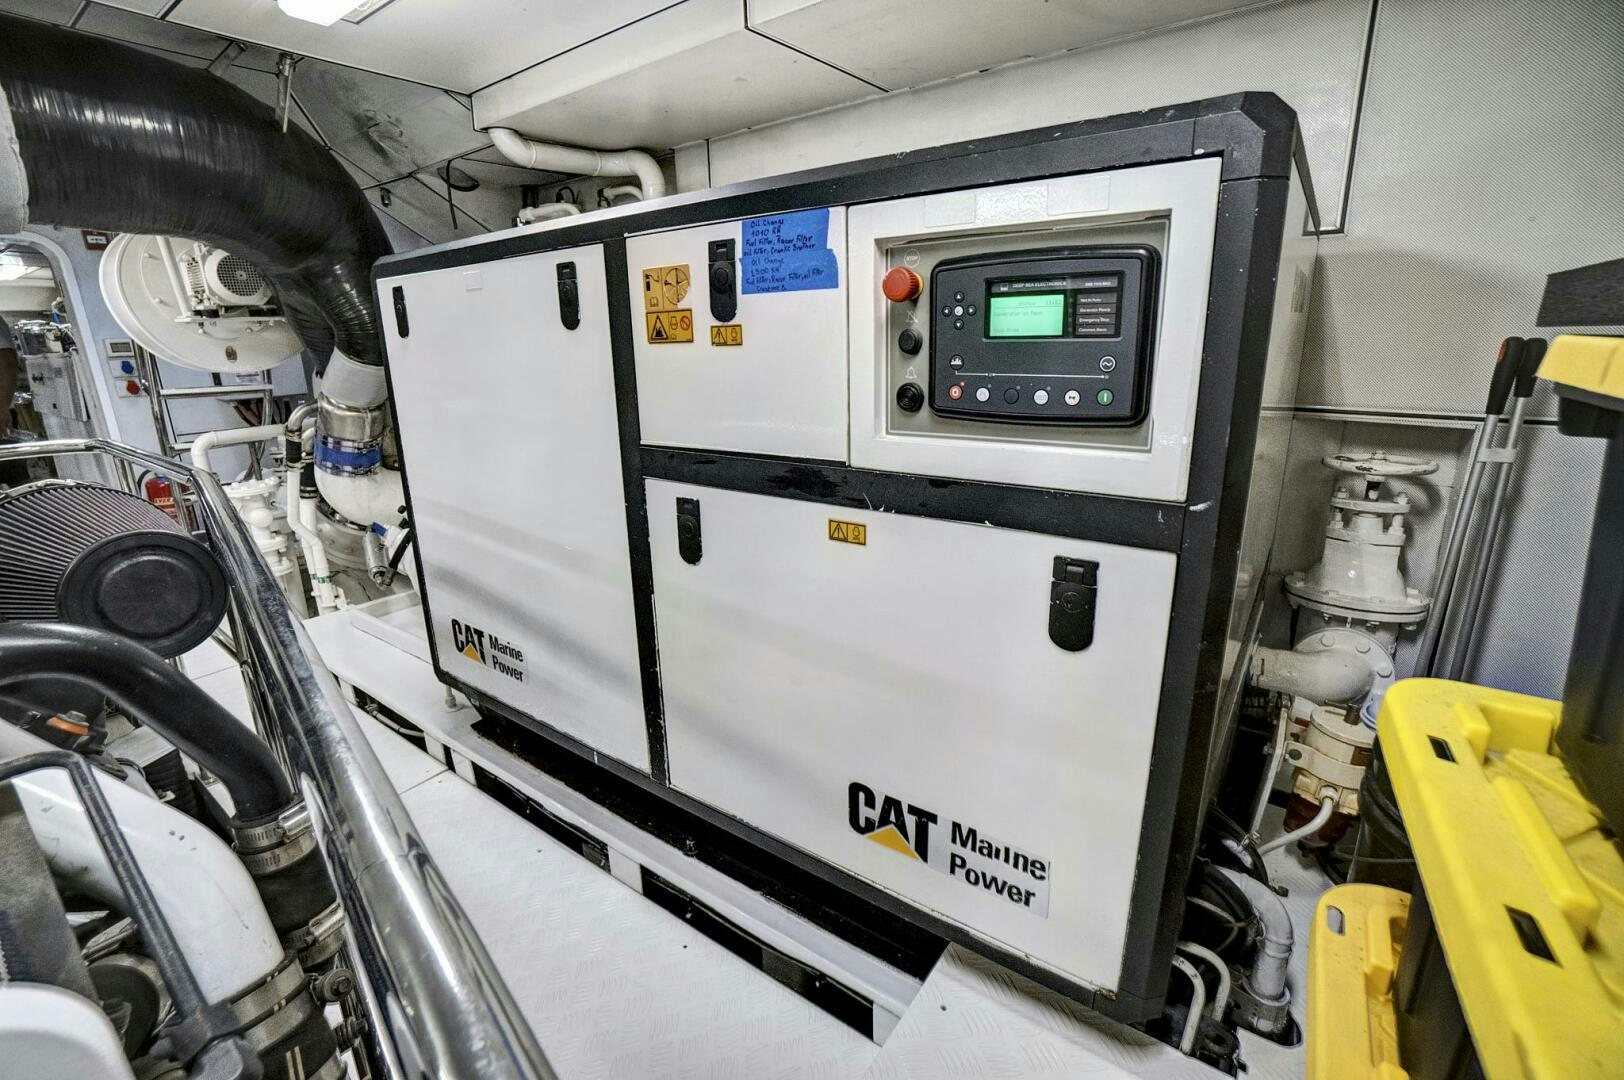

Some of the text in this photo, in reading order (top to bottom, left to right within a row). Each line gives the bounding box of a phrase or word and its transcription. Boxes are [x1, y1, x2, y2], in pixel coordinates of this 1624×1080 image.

[451, 618, 486, 665] CAT
[488, 633, 524, 662] Marine
[492, 654, 523, 682] Power
[848, 782, 937, 865] CAT
[951, 820, 1047, 882] Marine
[950, 851, 1036, 908] Power
